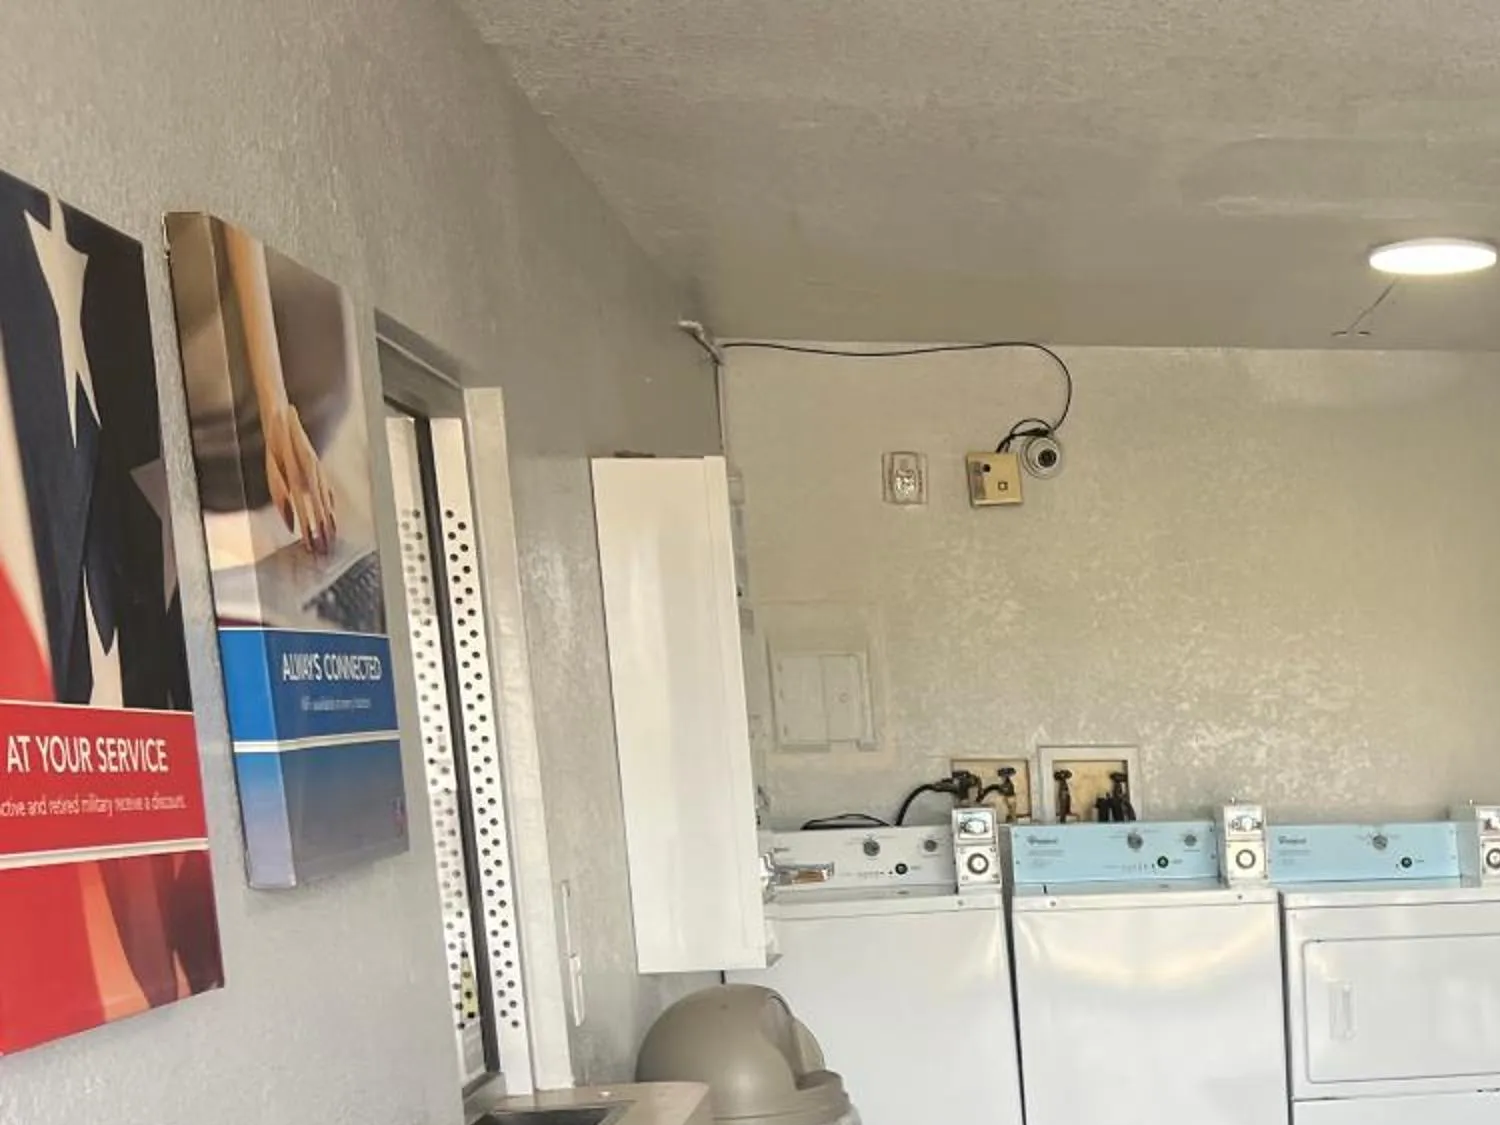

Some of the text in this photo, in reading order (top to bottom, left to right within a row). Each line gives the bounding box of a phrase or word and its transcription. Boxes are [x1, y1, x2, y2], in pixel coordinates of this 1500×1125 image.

[282, 652, 382, 681] ALWAYS CONNECTED
[7, 735, 169, 773] AT YOUR SERVICE
[0, 795, 26, 816] ctive
